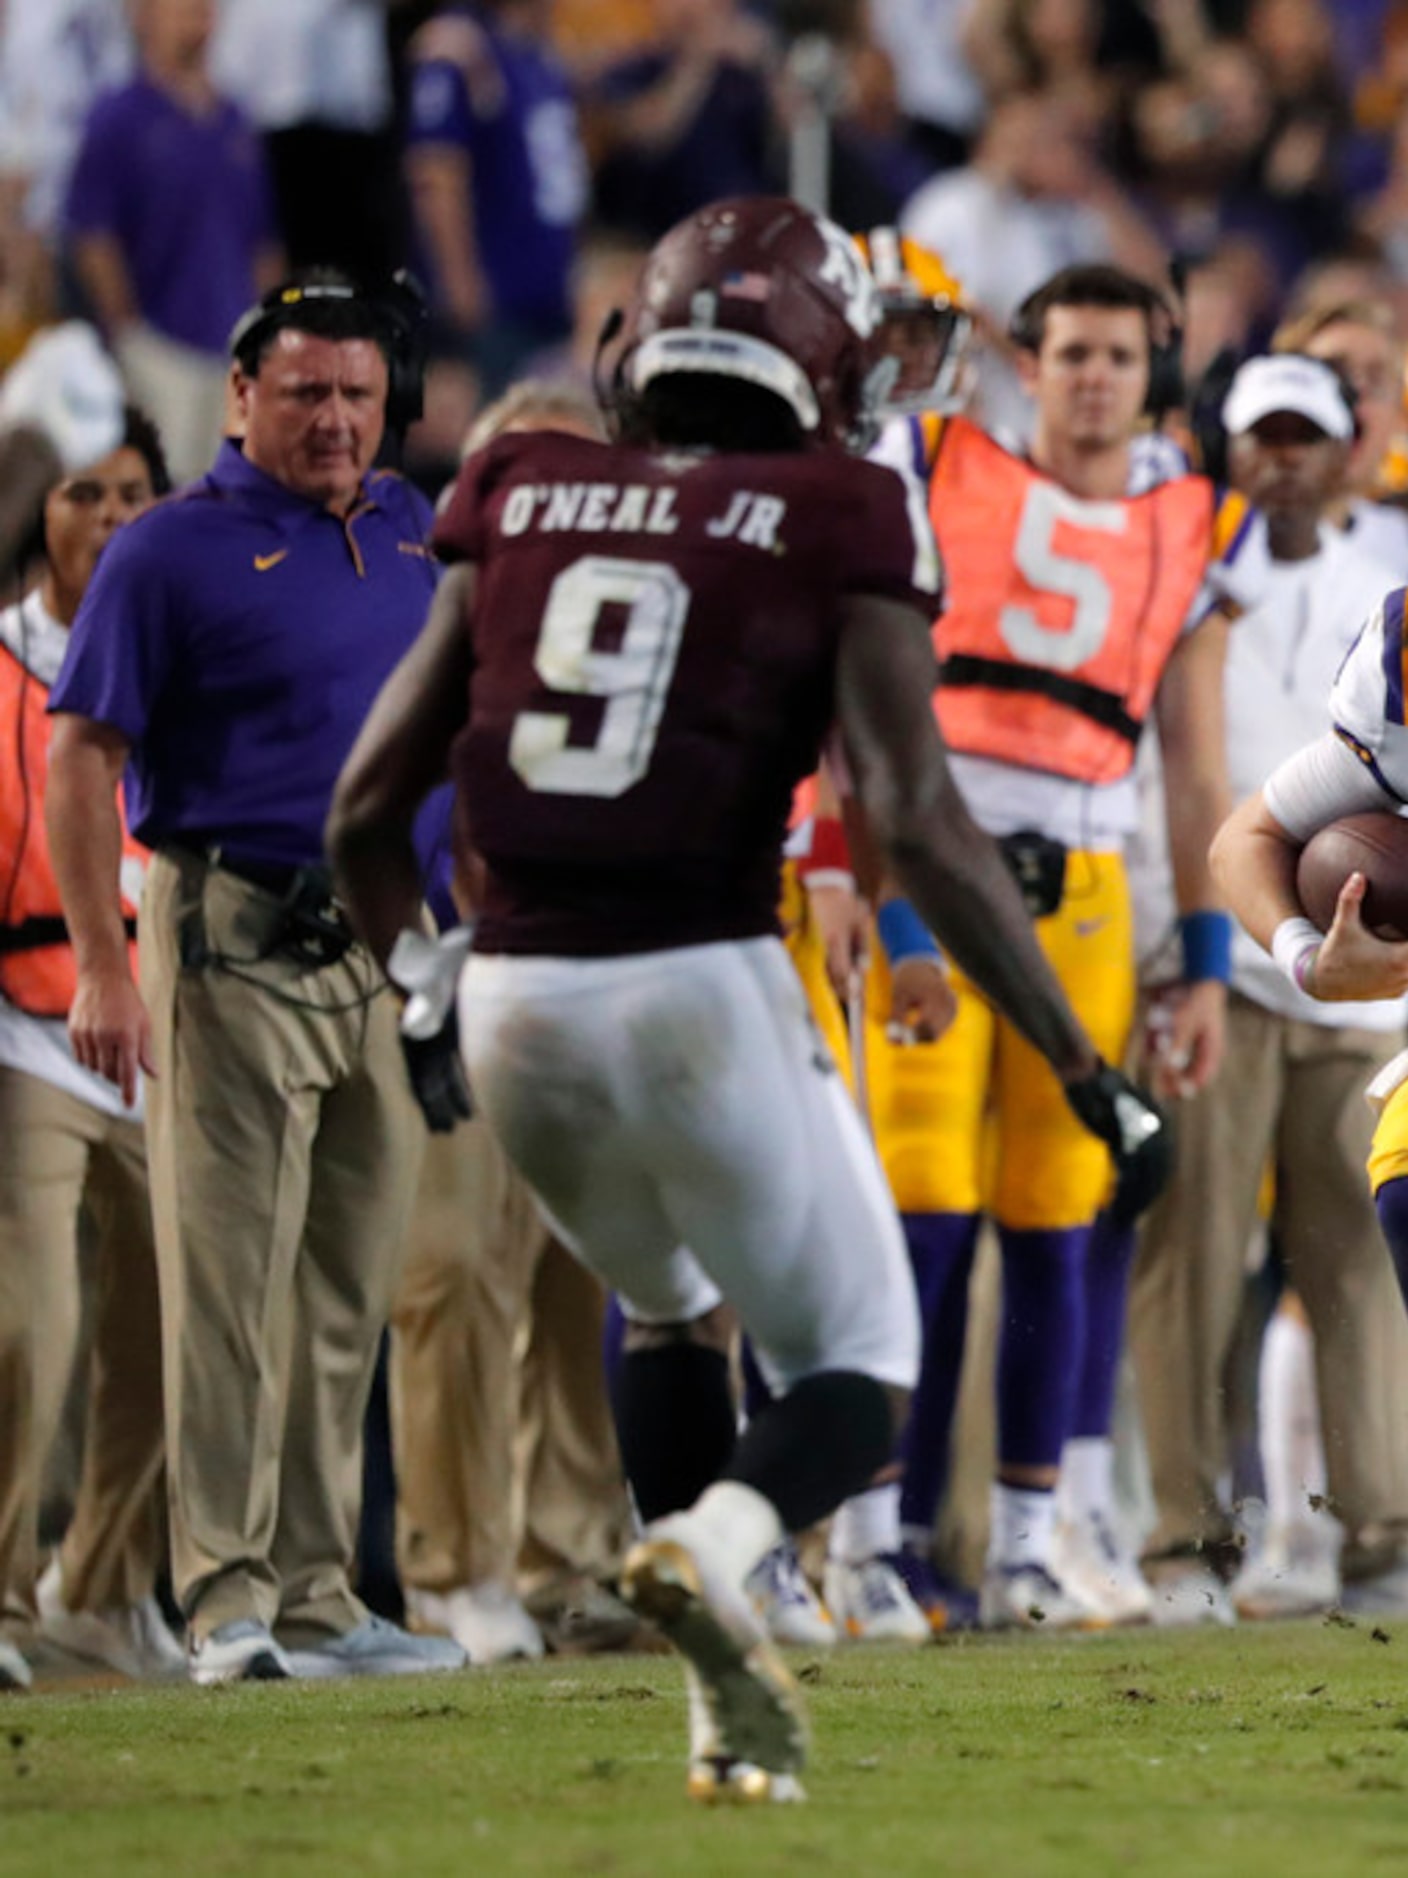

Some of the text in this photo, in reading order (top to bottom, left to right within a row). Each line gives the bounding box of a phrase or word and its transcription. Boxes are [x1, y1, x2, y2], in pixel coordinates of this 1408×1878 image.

[502, 485, 678, 537] O'NEAL
[999, 478, 1128, 674] 5
[508, 554, 691, 799] 9
